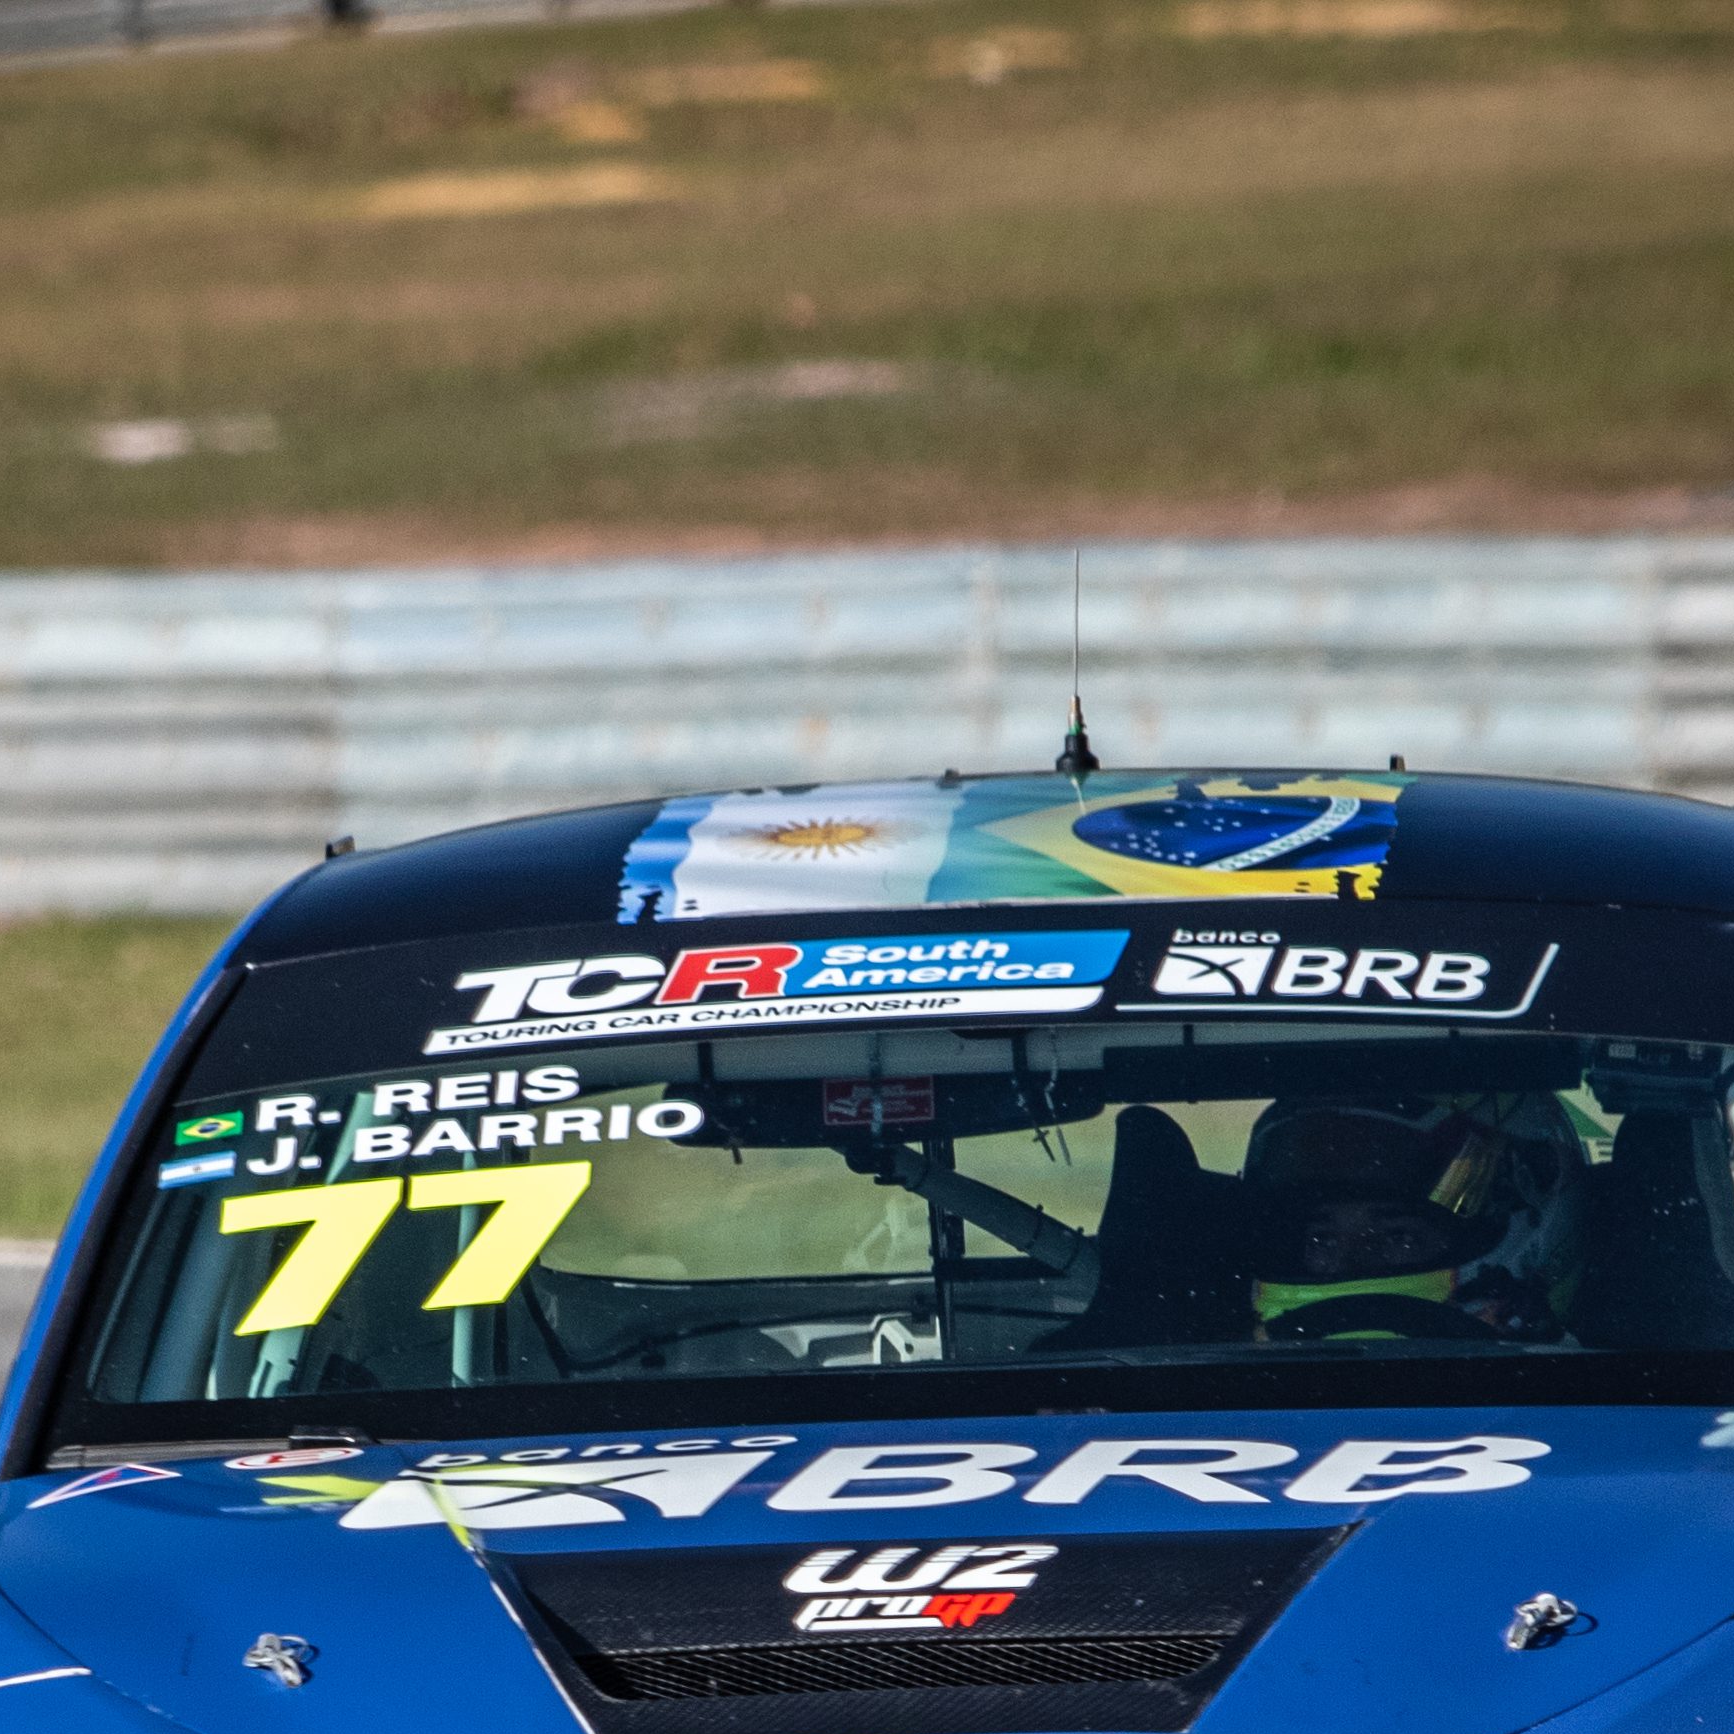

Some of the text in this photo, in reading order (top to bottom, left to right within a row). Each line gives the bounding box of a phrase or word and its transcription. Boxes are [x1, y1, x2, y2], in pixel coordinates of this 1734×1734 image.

[819, 940, 1010, 966] South
[1171, 928, 1282, 944] banco
[456, 944, 803, 1024] TCR
[802, 957, 1076, 989] America
[1270, 946, 1492, 1001] BRB
[444, 996, 962, 1047] TOURING CAR CHAMPIONSHIP
[255, 1065, 581, 1133] R. REIS
[245, 1101, 705, 1177] J. BARRIO
[219, 1160, 592, 1337] 77
[415, 1434, 799, 1469] banco
[765, 1435, 1553, 1512] BRB
[783, 1543, 1060, 1593] W2
